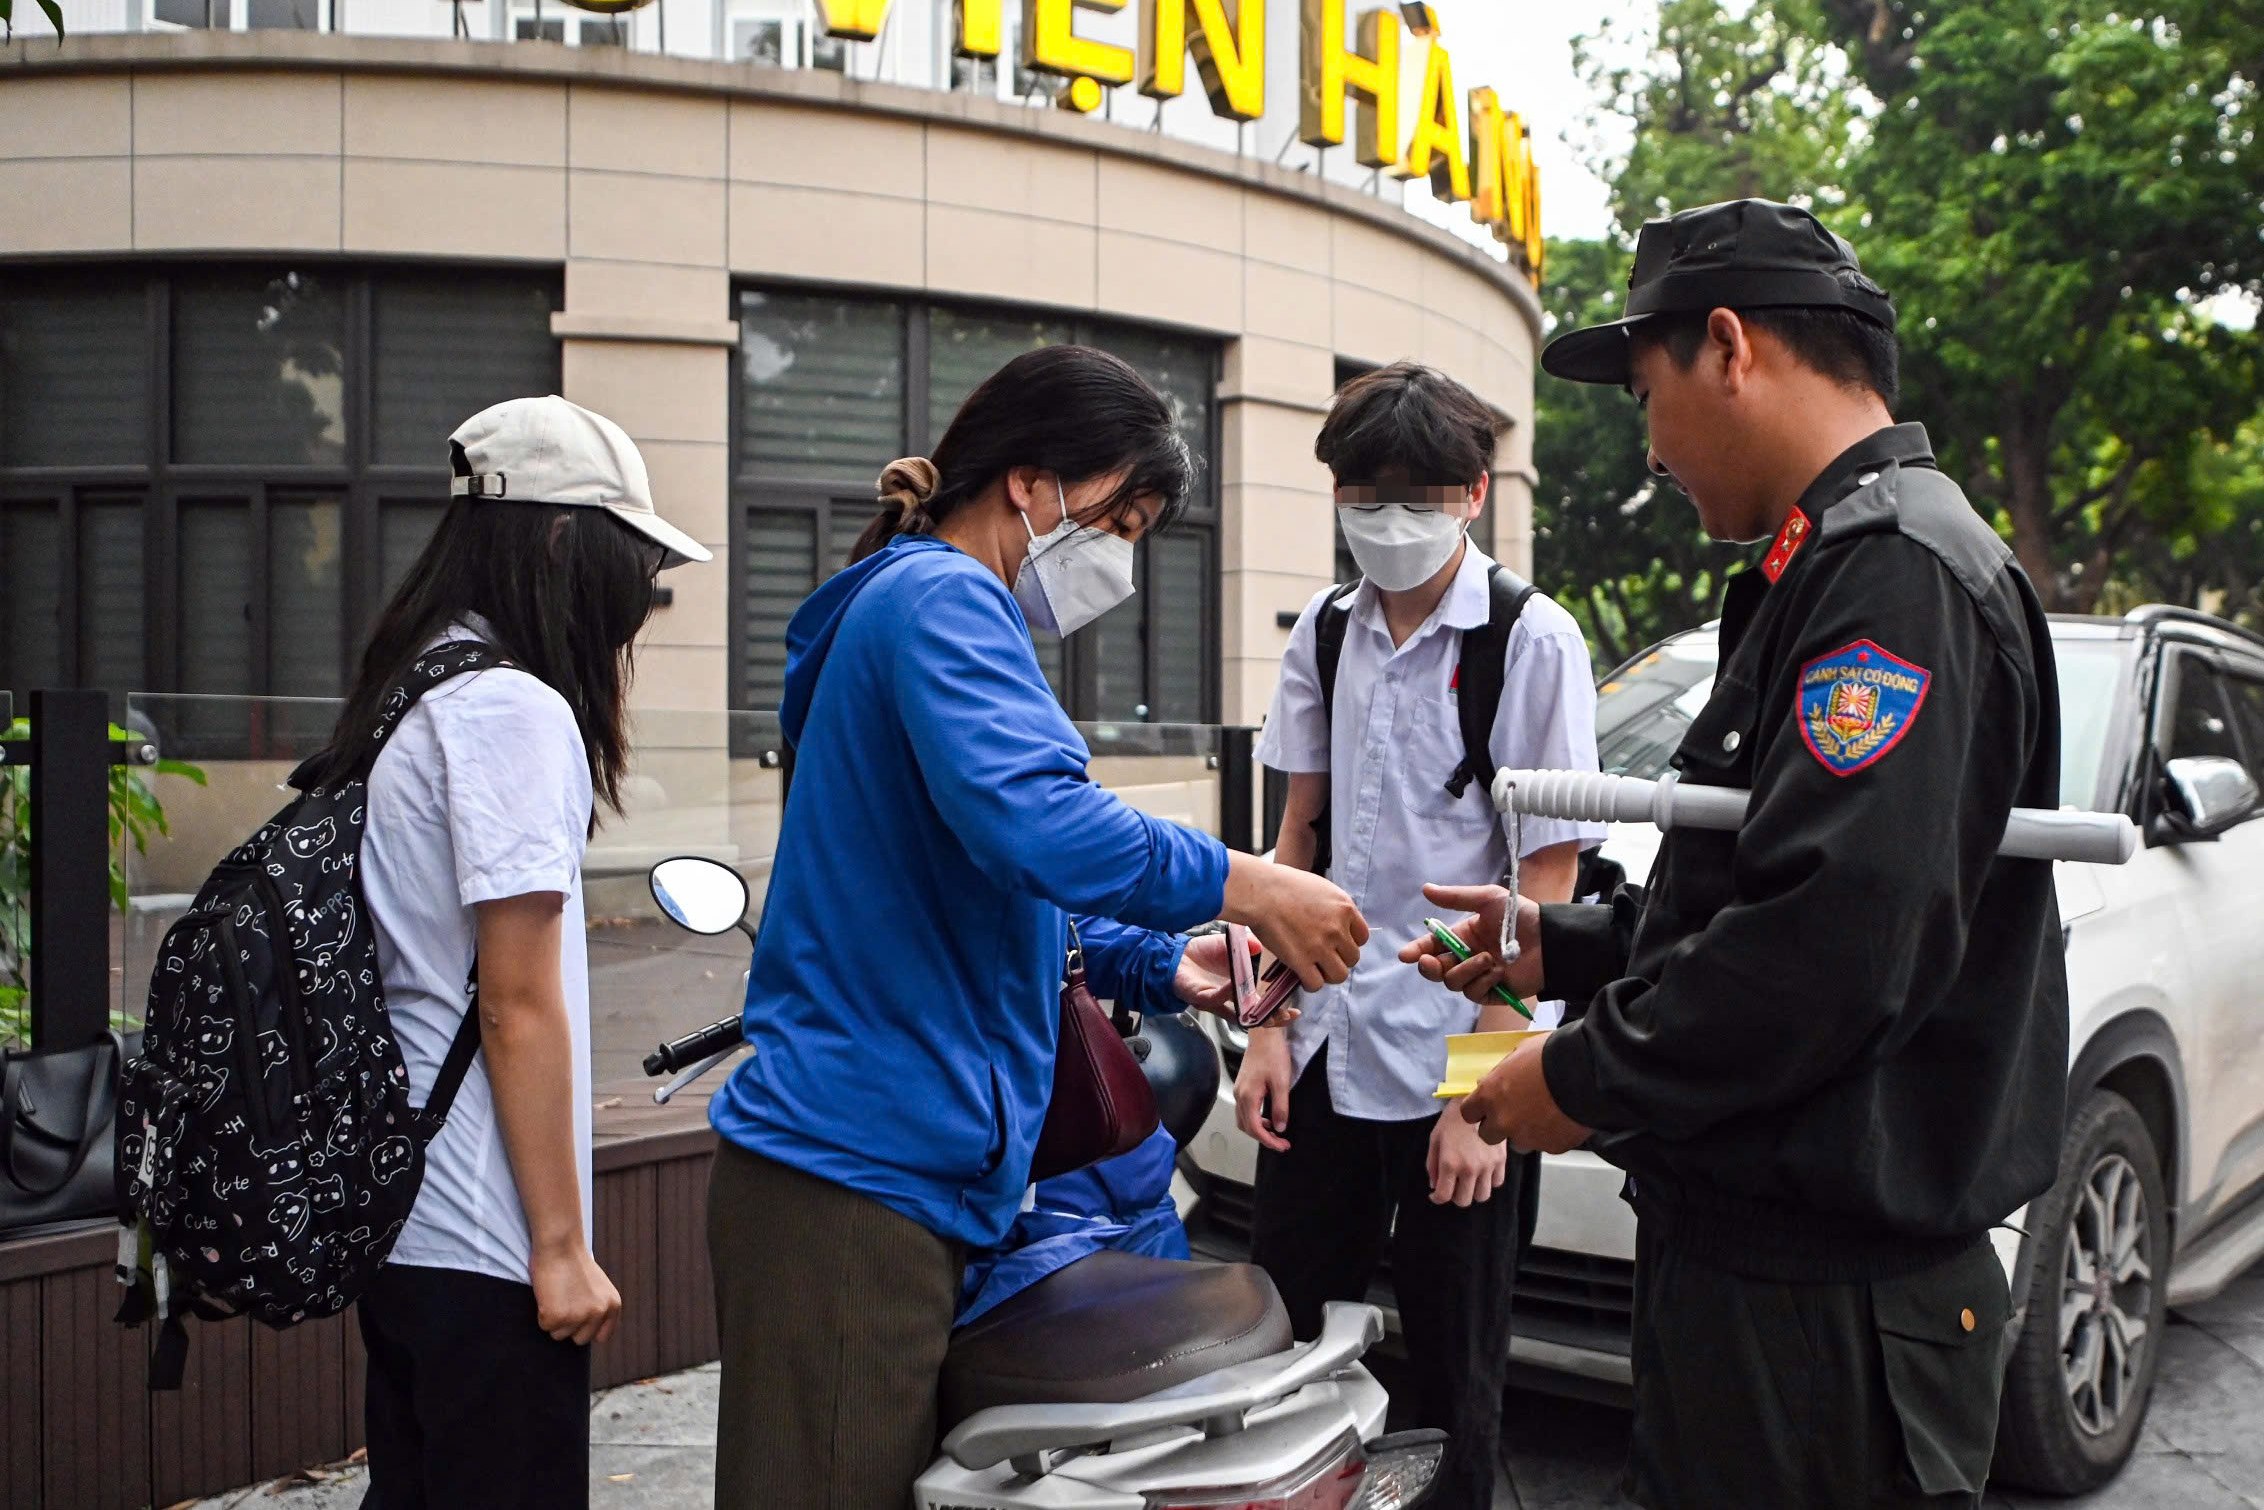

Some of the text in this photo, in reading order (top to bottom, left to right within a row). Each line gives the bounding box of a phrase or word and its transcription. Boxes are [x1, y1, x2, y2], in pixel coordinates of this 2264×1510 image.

[1301, 0, 1471, 203] HÀ
[321, 852, 355, 874] Cute
[184, 1213, 218, 1230] Cute
